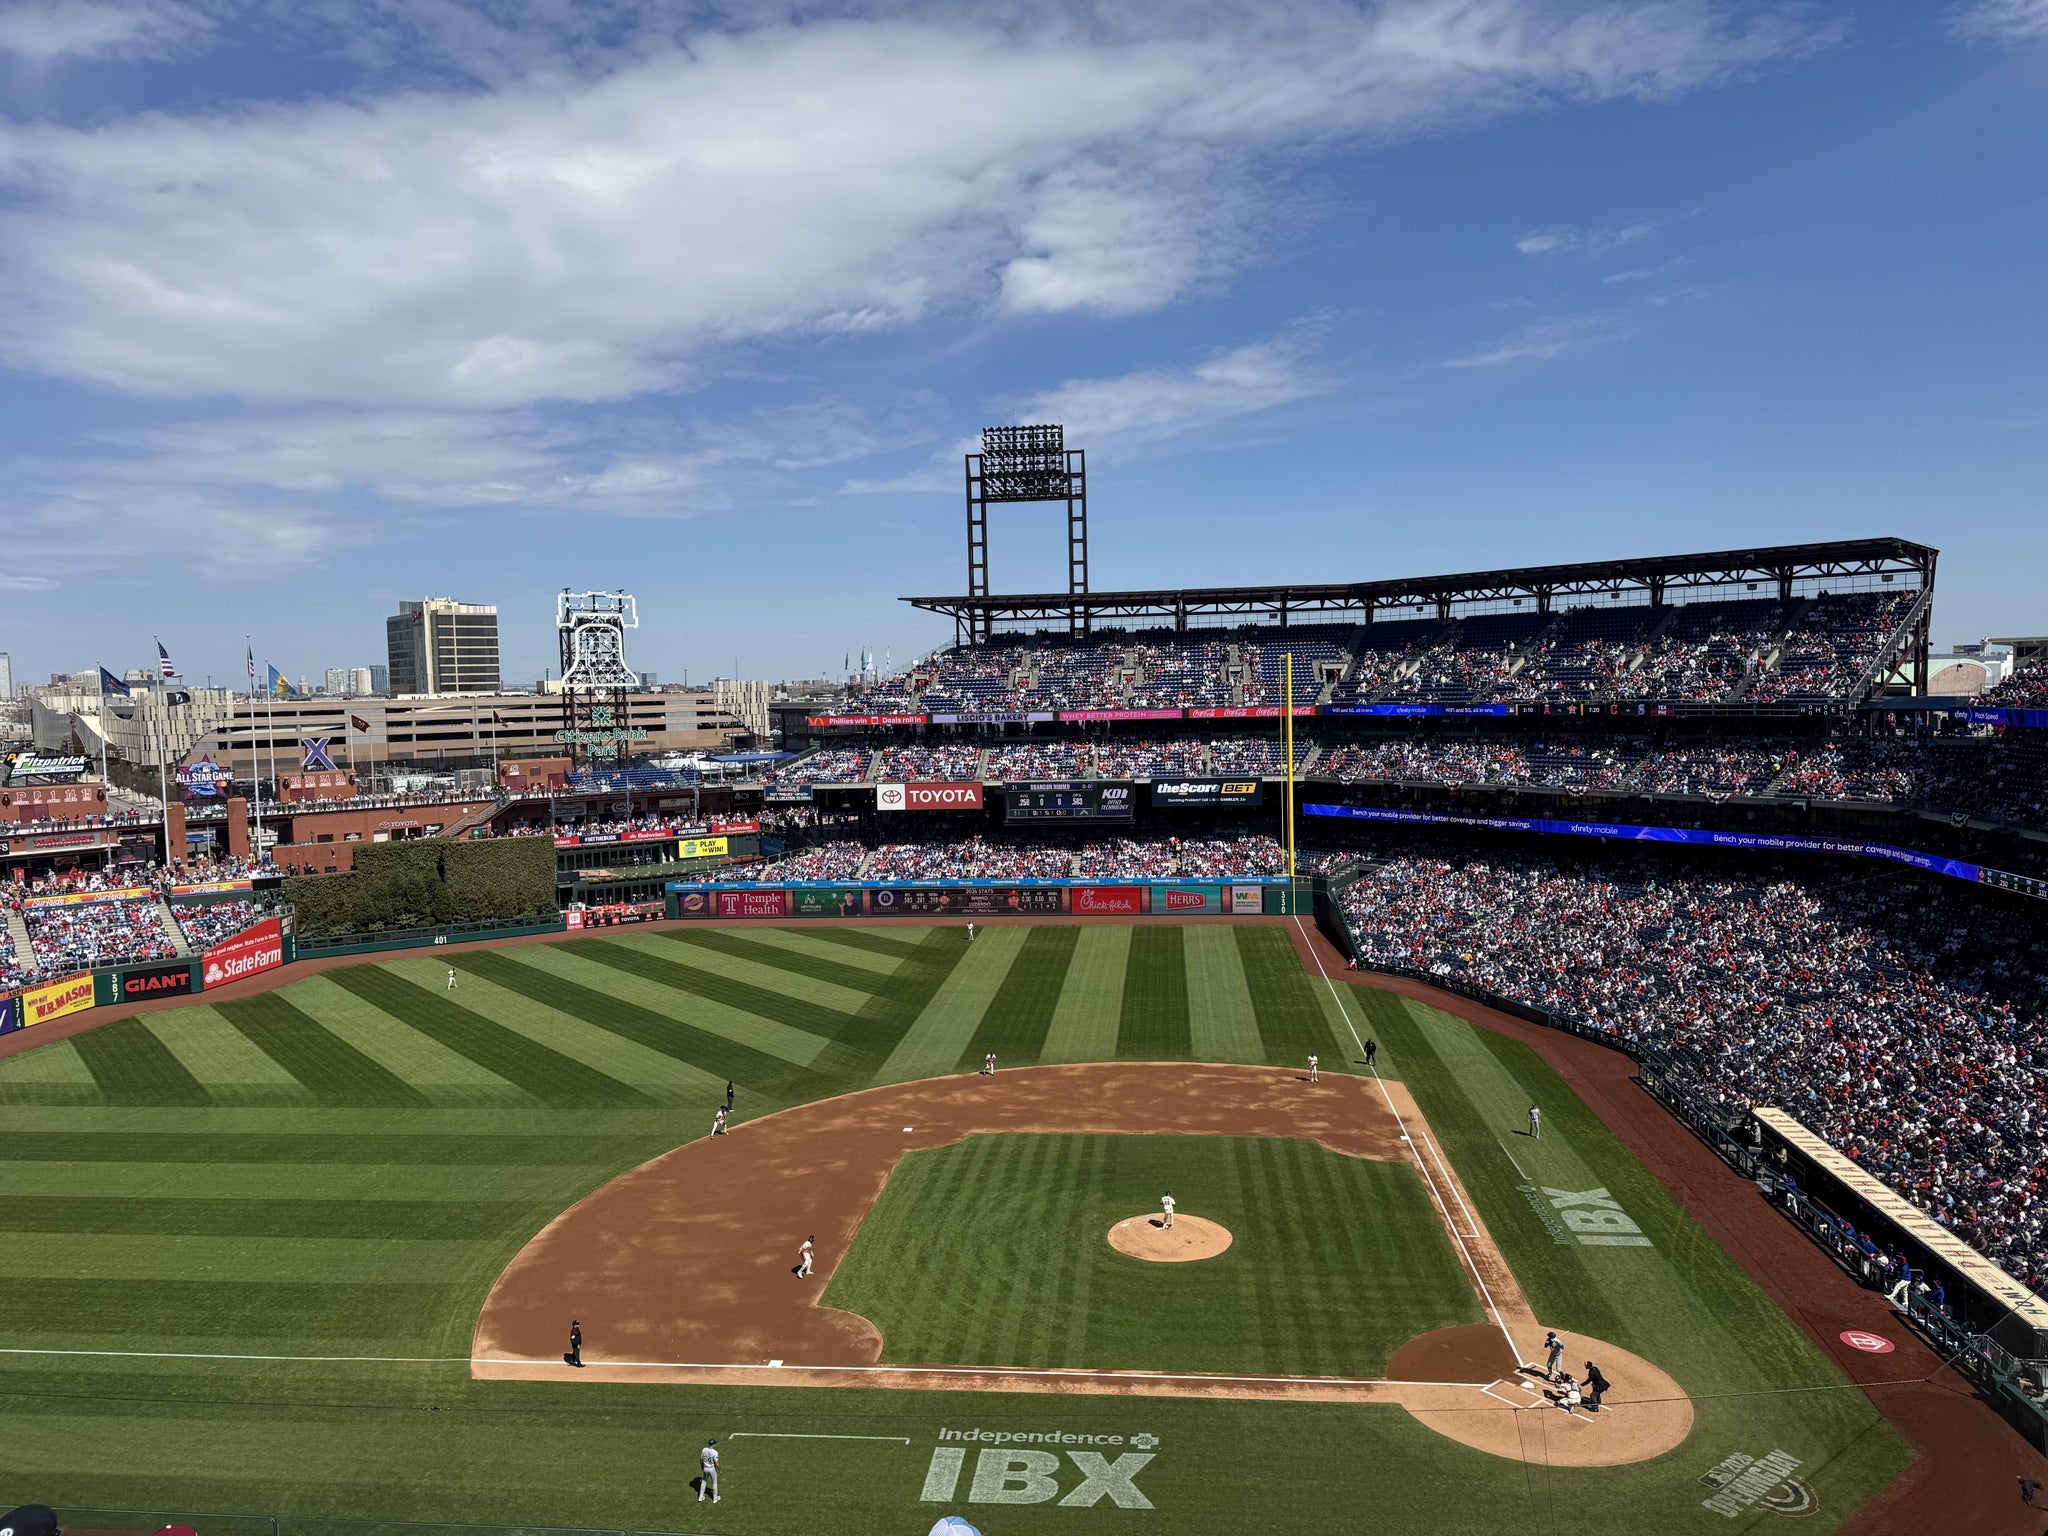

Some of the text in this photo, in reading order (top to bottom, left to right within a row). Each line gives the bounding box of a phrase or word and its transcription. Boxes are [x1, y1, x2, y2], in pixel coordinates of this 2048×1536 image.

[1954, 711, 1968, 720] xfinity
[556, 726, 646, 743] Citizens Bank
[588, 744, 617, 757] Park
[192, 773, 211, 781] STAR
[213, 772, 234, 780] GAME
[1157, 783, 1253, 793] theScore BET
[909, 790, 976, 803] TOYOTA
[1400, 812, 1422, 821] provider
[1450, 816, 1476, 824] coverage
[1489, 818, 1507, 827] bigger
[1508, 820, 1532, 829] savings.
[1570, 824, 1619, 834] xfinity mobile
[1714, 835, 1931, 867] Bench your mobile provider for better coverage and bigger savings.
[189, 885, 218, 894] Surfside
[32, 897, 64, 907] Surfside
[94, 893, 125, 901] Surfside
[743, 893, 780, 903] Temple
[1080, 891, 1132, 911] Chick-fil-A
[1170, 895, 1200, 905] HERR'S
[744, 905, 778, 914] Health
[434, 936, 447, 944] 401
[217, 948, 226, 956] good
[52, 971, 87, 986] ASPLUNDH
[125, 973, 189, 992] GIANT
[8, 984, 44, 998] ASPLUNDH
[1540, 1186, 1654, 1247] IBX
[938, 1428, 1124, 1446] Independence
[1720, 1452, 1755, 1473] 2026
[920, 1446, 1158, 1510] IBX
[1701, 1448, 1803, 1518] OPENING DAY
